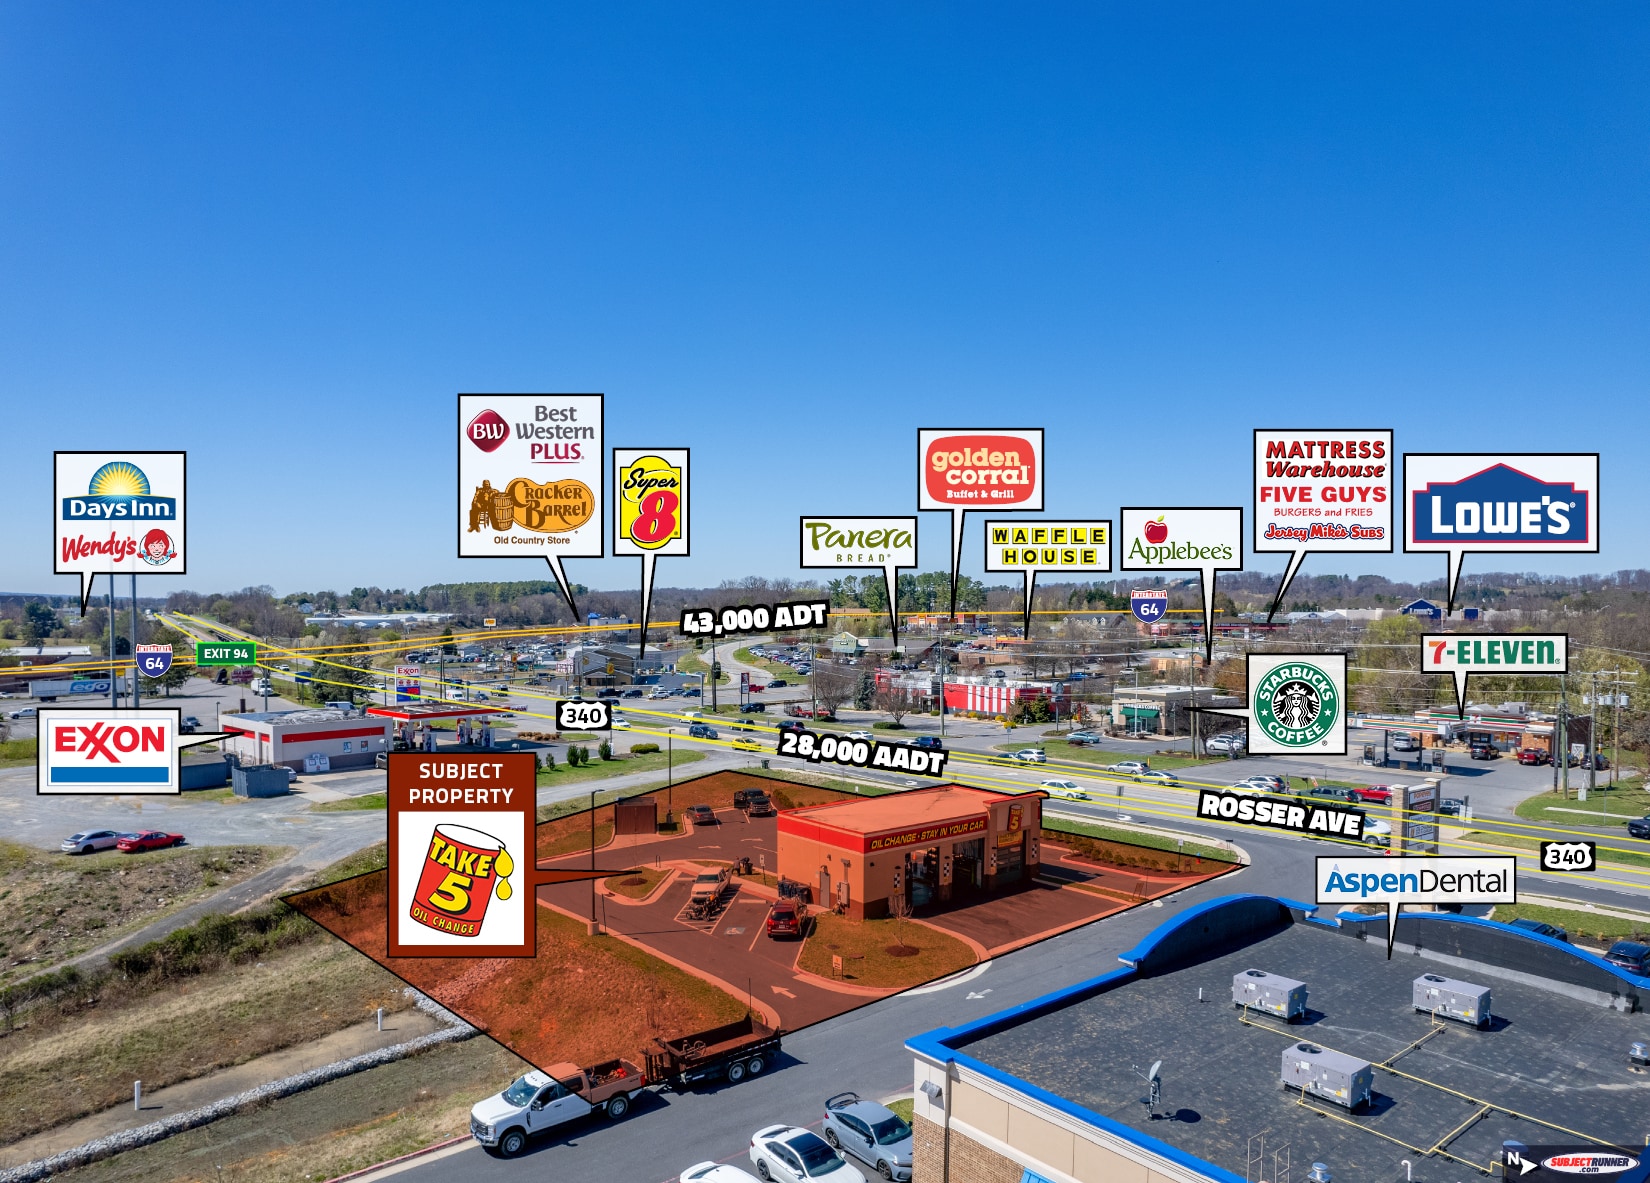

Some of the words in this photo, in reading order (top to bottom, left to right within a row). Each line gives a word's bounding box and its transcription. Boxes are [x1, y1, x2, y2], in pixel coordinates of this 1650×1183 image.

[1010, 816, 1019, 830] 5
[871, 840, 883, 849] OIL
[884, 833, 917, 847] CHANGE
[921, 829, 938, 840] STAY
[940, 827, 947, 835] IN
[949, 823, 968, 834] YOUR
[969, 820, 984, 830] CAR
